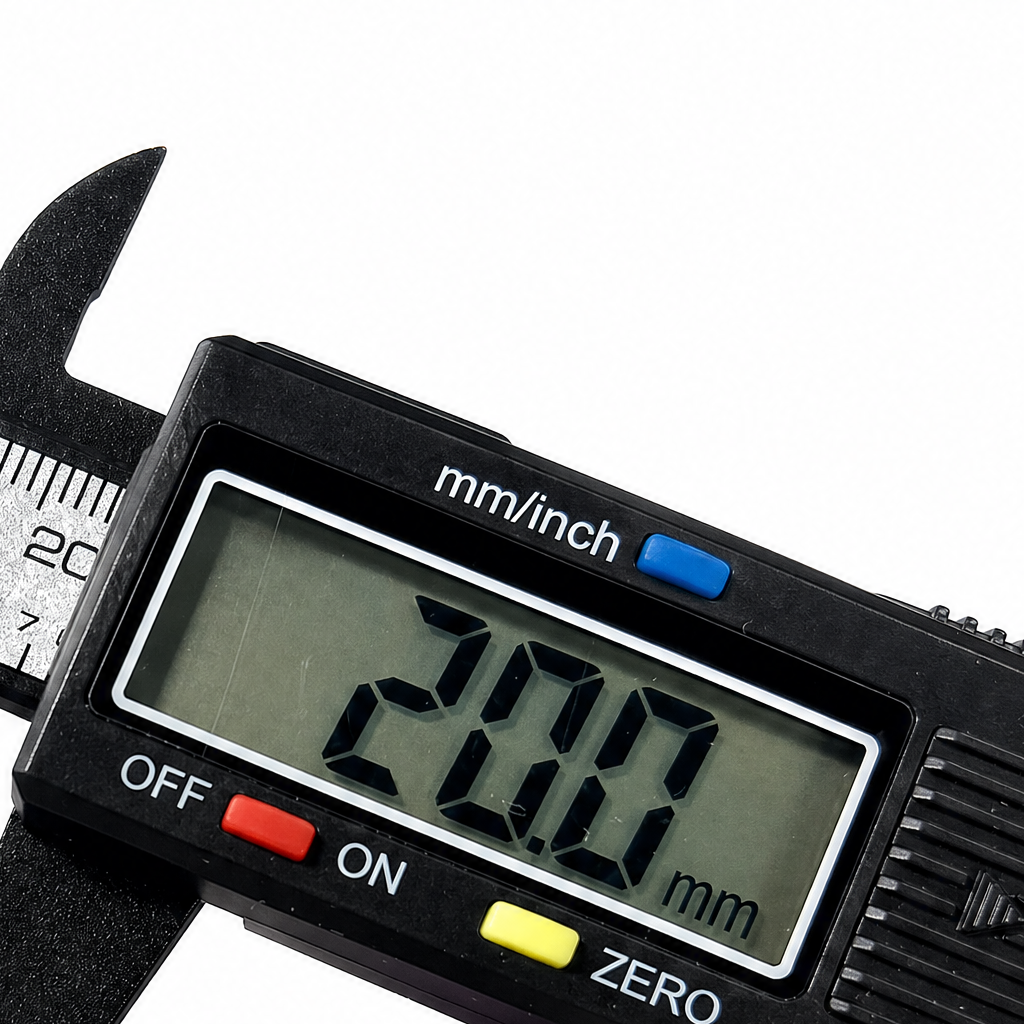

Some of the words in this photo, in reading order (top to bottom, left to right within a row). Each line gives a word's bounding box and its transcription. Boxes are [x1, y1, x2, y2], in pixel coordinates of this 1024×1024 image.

[434, 463, 622, 563] mm/inch
[23, 525, 99, 581] 20
[16, 610, 40, 632] 7
[119, 754, 213, 810] OFF
[322, 594, 719, 890] 20.0
[662, 868, 760, 940] mm
[336, 841, 409, 895] ON
